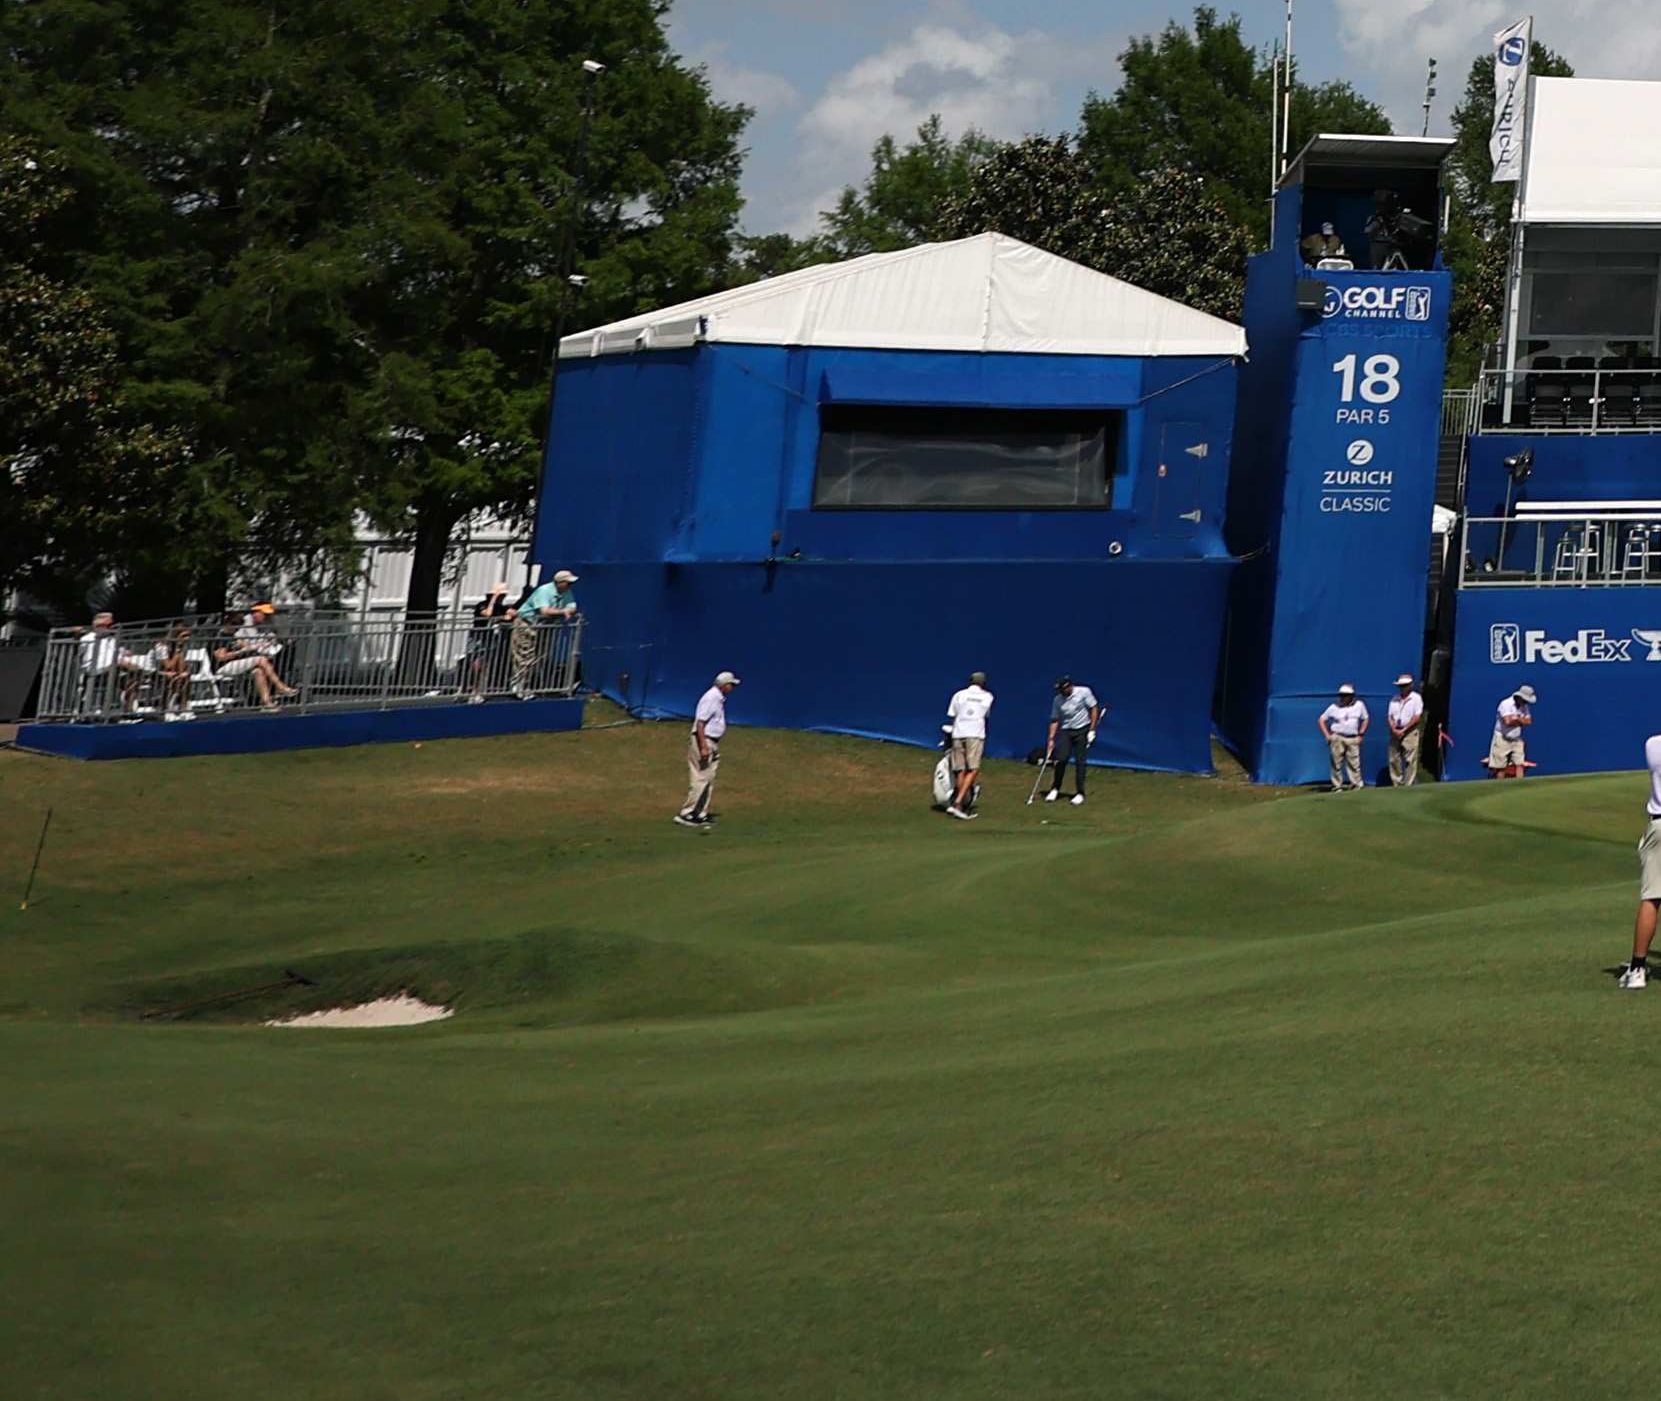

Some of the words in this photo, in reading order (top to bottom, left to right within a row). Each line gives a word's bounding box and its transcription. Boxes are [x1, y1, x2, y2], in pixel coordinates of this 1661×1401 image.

[1343, 286, 1406, 310] GOLF
[1344, 309, 1401, 319] CHANNEL
[1332, 353, 1401, 404] 18
[1336, 408, 1374, 425] PAR
[1377, 409, 1390, 425] 5
[1322, 470, 1393, 485] ZURICH
[1319, 496, 1392, 513] CLASSIC
[1524, 629, 1633, 664] FedEx
